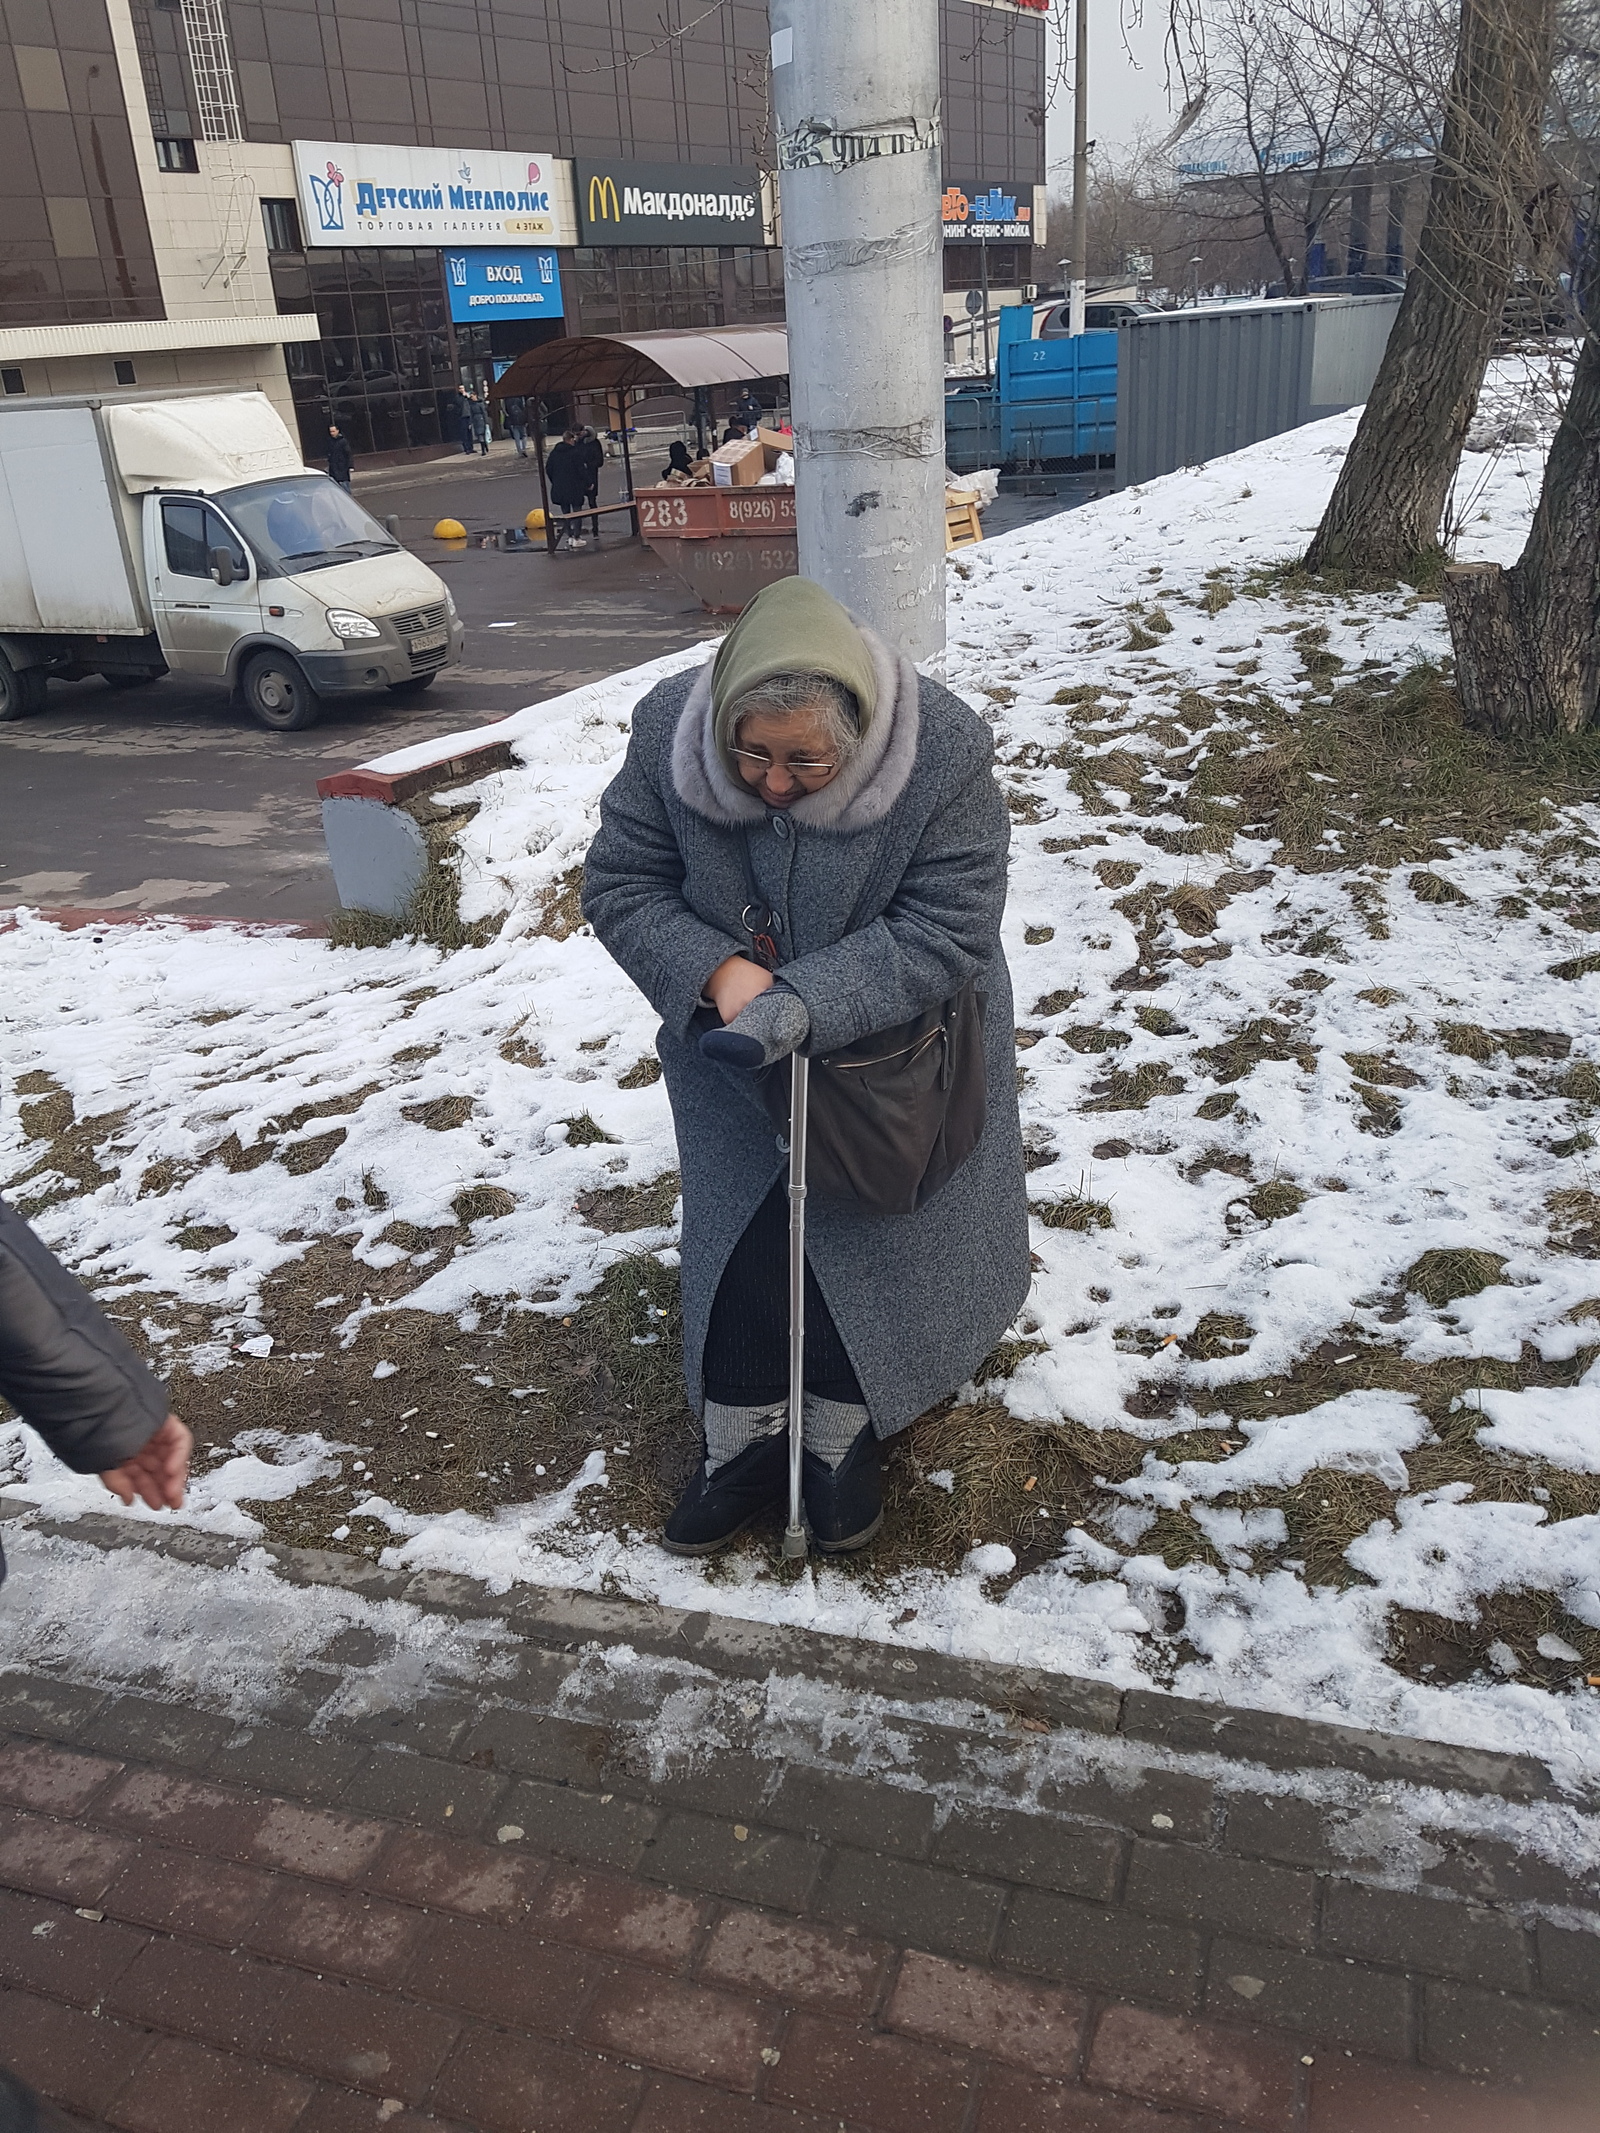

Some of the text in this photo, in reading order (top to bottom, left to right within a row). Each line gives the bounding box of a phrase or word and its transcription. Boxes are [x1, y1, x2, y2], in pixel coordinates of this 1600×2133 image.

[623, 187, 756, 221] Макдоналдс
[357, 221, 501, 231] ТОРГОВАЯ ГАЛЕРЕЯ
[523, 222, 544, 231] ЭТАЖ
[944, 222, 1030, 238] НИНГ СЕРВИС МОЙКА
[486, 265, 523, 284] ВХОД
[469, 292, 544, 306] ДОБРО ПОЖАЛОВАТЬ
[1033, 350, 1046, 361] 22
[640, 498, 689, 527] 283
[729, 498, 776, 523] 8(926)
